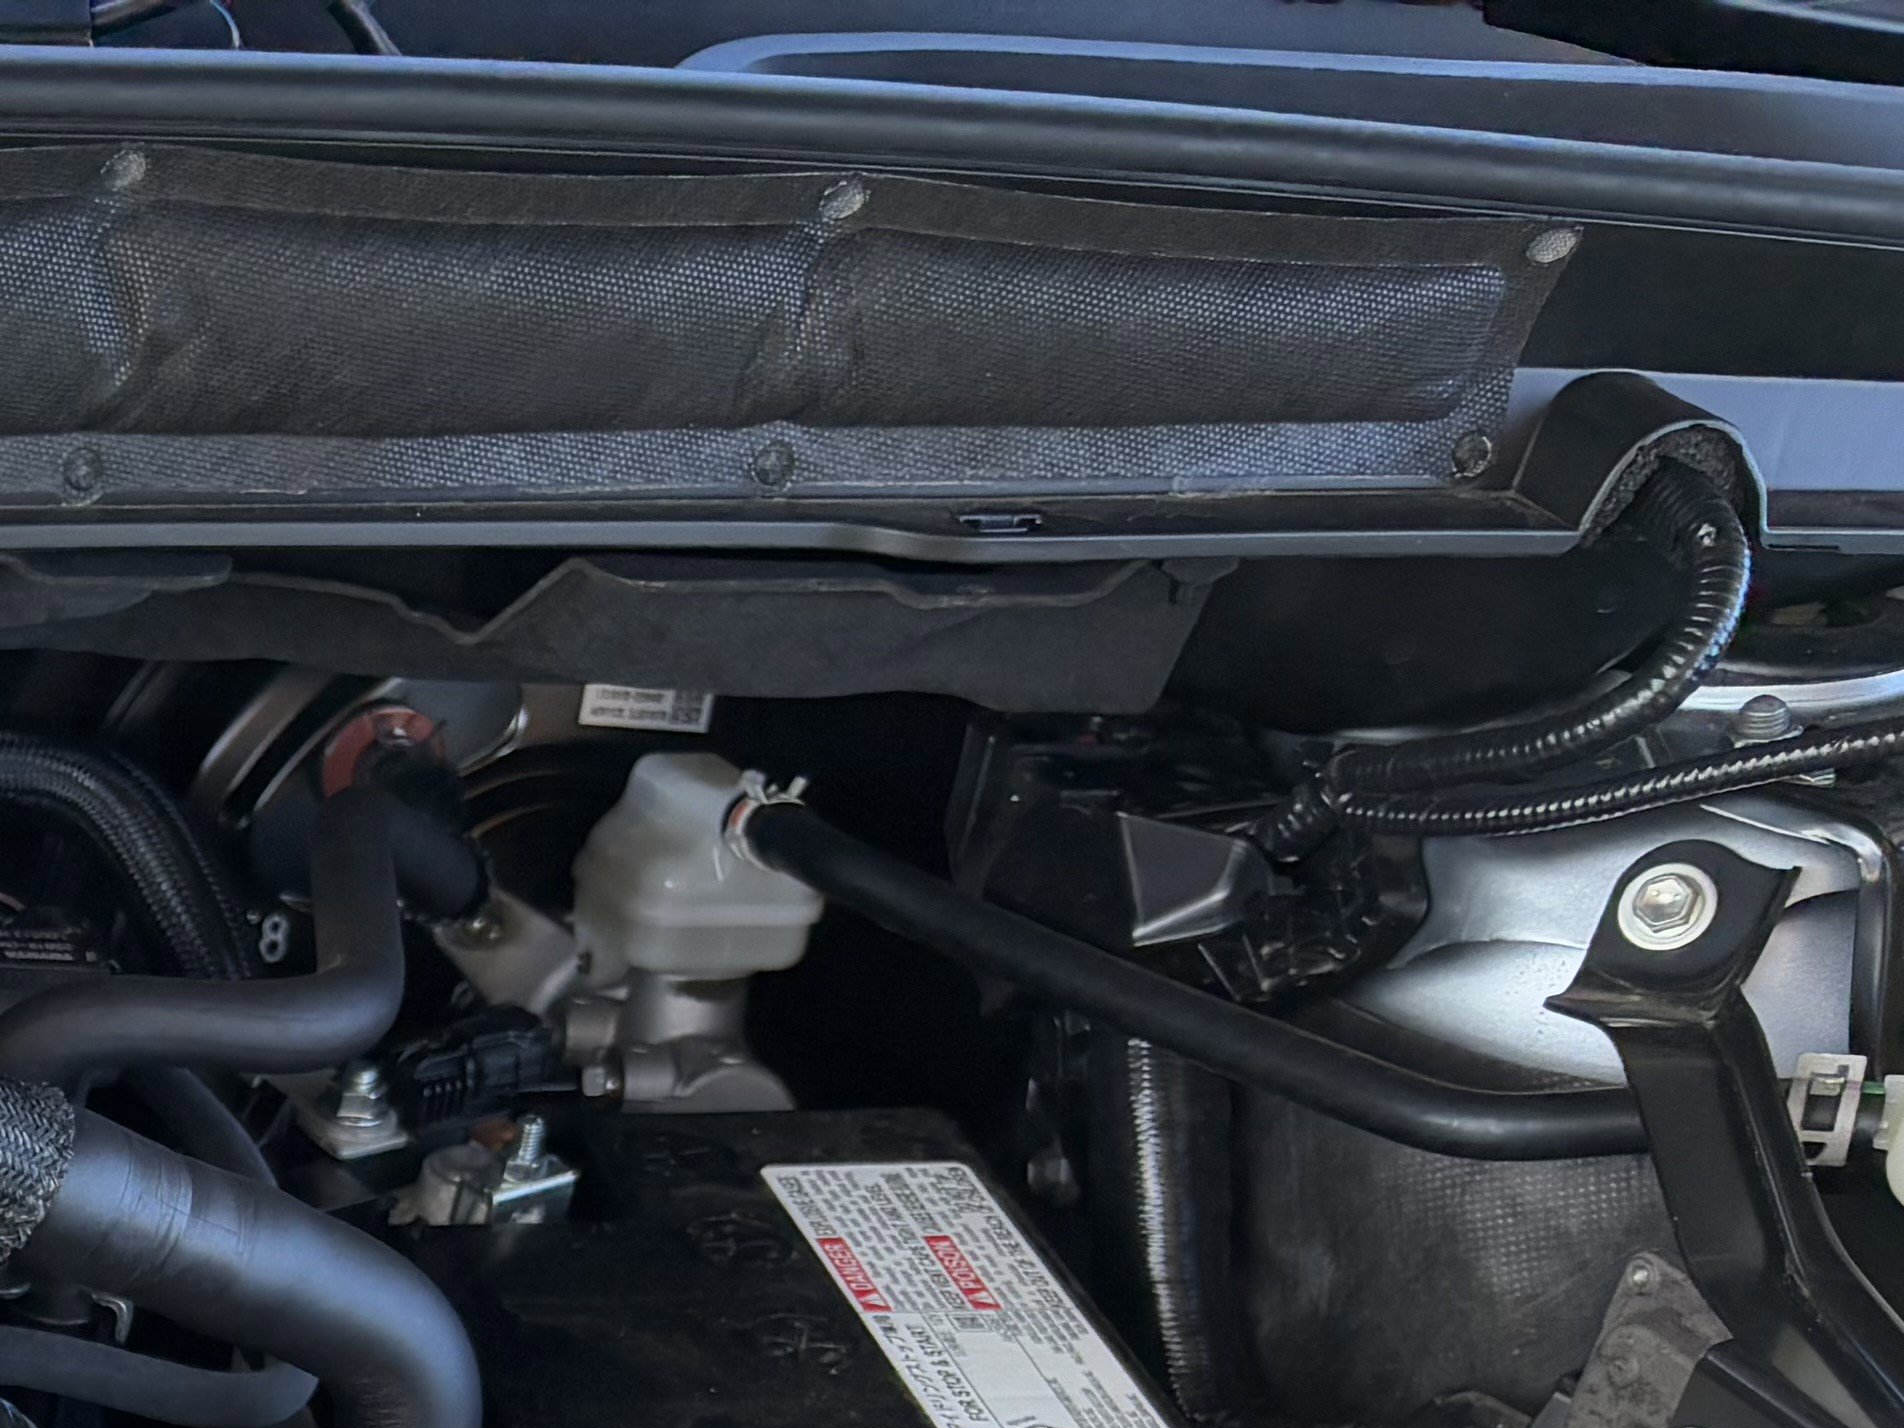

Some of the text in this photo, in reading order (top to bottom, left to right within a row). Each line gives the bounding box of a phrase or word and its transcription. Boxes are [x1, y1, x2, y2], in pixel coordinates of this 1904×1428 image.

[823, 1243, 875, 1290] DANGER
[903, 1324, 943, 1356] START
[936, 1370, 971, 1396] STOP
